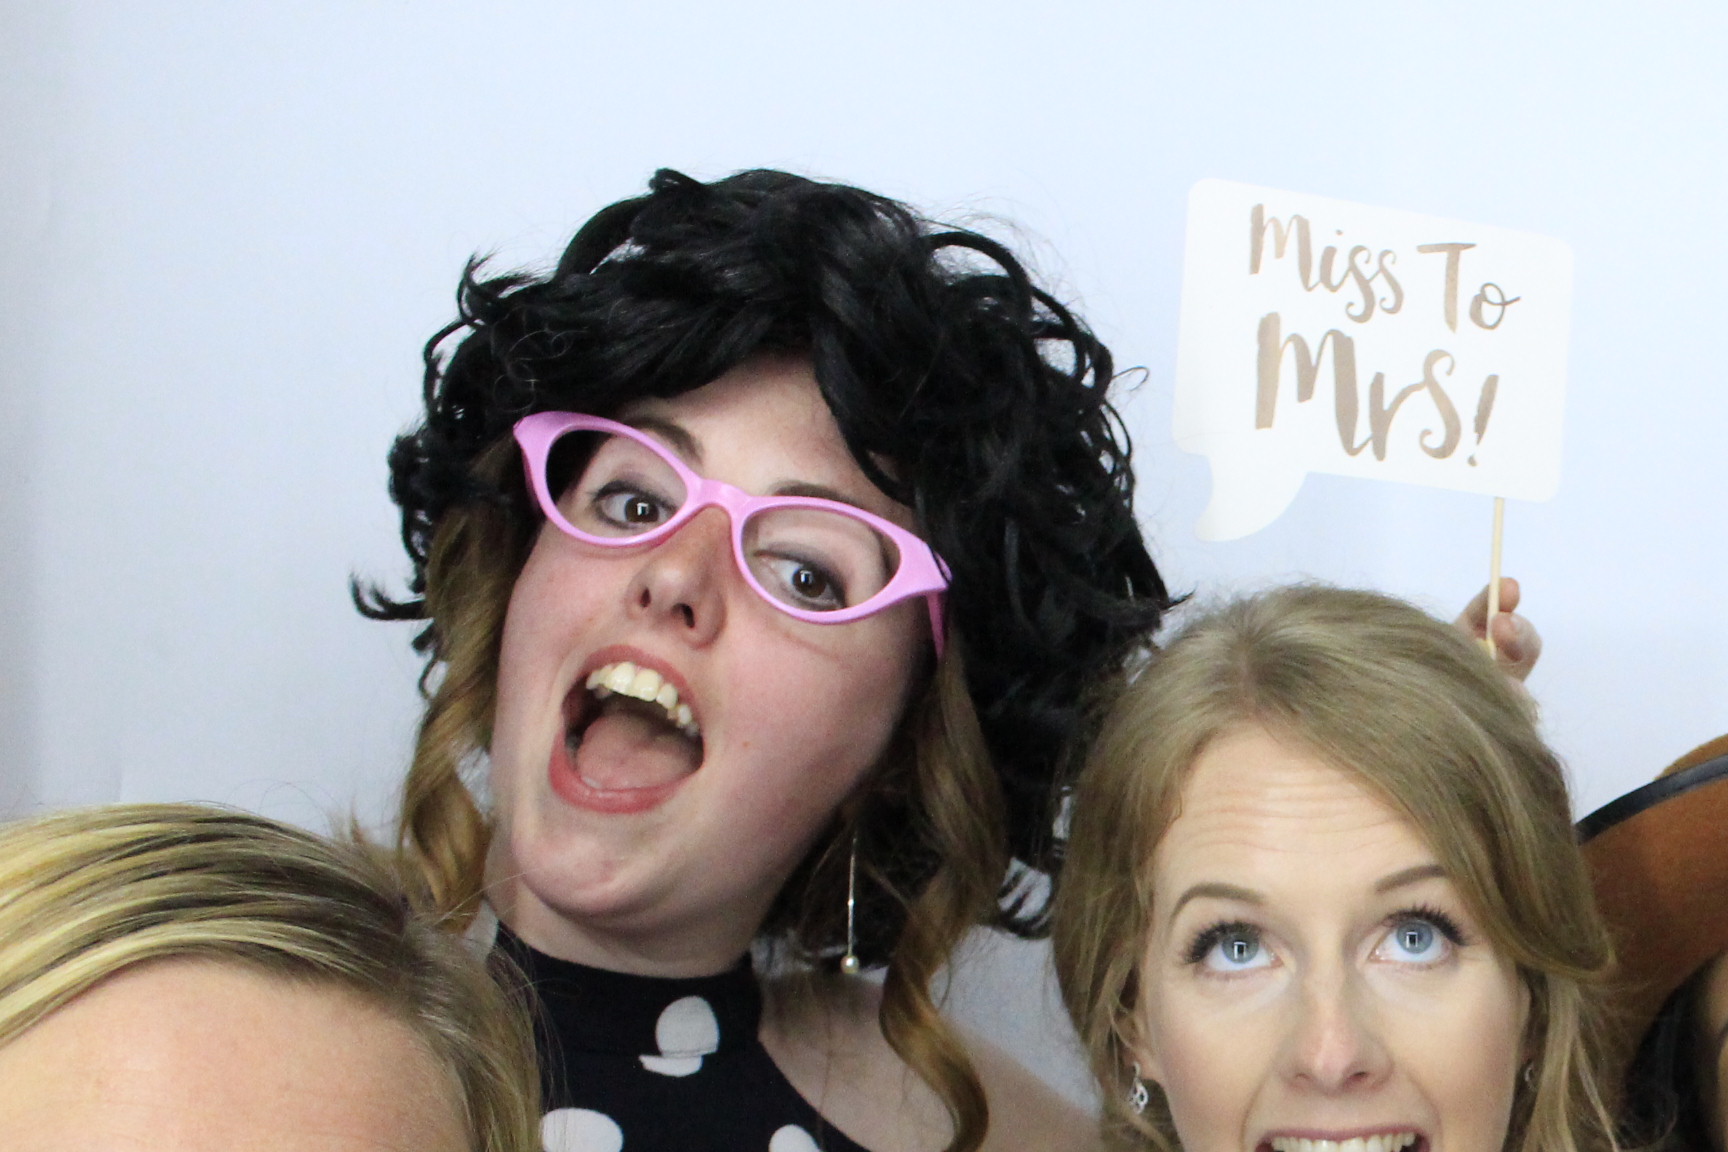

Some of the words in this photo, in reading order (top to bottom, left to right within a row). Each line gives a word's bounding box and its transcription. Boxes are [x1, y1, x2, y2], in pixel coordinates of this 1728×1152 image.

[1250, 203, 1404, 323] Miss
[1417, 243, 1520, 332] To
[1255, 312, 1499, 466] Mrs!
